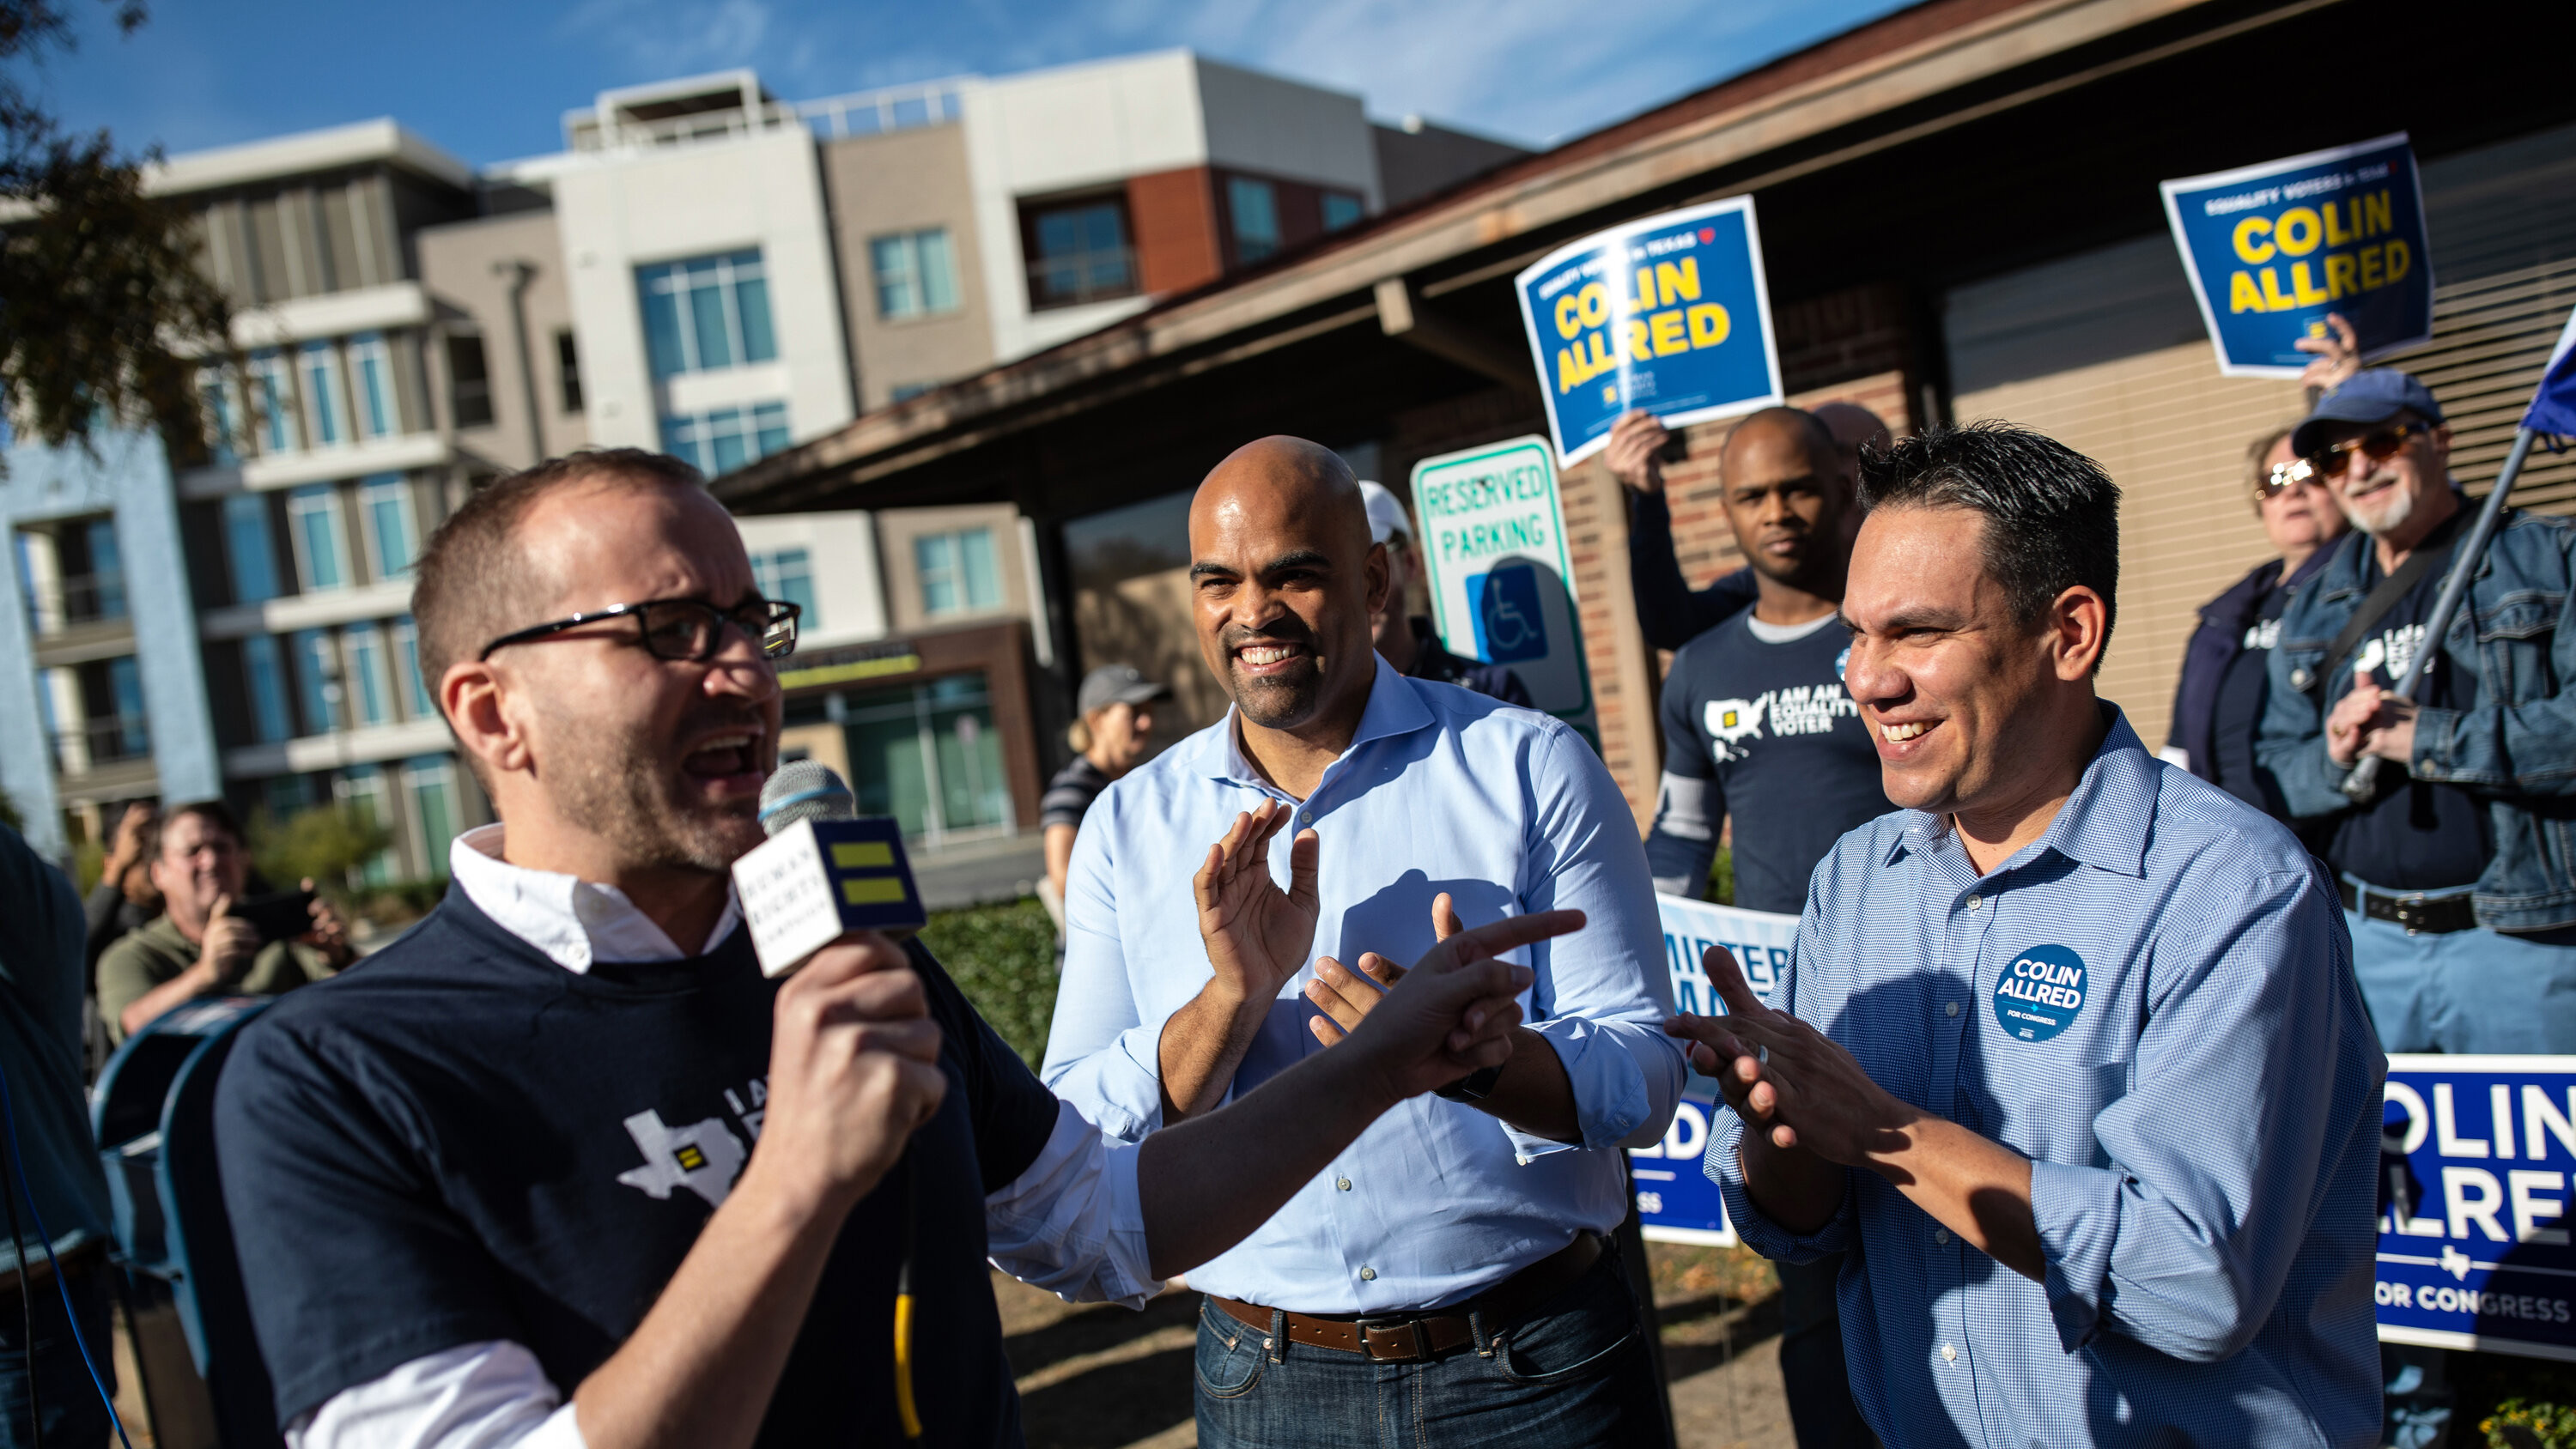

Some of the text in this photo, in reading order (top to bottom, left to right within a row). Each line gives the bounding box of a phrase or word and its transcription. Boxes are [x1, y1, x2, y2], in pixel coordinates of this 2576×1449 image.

[2233, 189, 2392, 265] COLIN
[2230, 239, 2410, 314] ALLRED
[1557, 302, 1731, 395] ALLRED
[1425, 464, 1546, 518] RESERVED
[1440, 514, 1546, 563] PARKING
[1769, 684, 1843, 705] I AM AN
[1770, 699, 1858, 719] EQUALITY
[1770, 715, 1833, 737] VOTER
[1664, 933, 1789, 984] MITE
[2014, 959, 2082, 987] COLIN
[1997, 977, 2081, 1009] ALLRED
[2007, 1009, 2057, 1026] FOR CONGRESS
[2381, 1081, 2576, 1161] OLIN
[2377, 1165, 2576, 1246] LRE
[2375, 1282, 2571, 1324] OR CONGRESS
